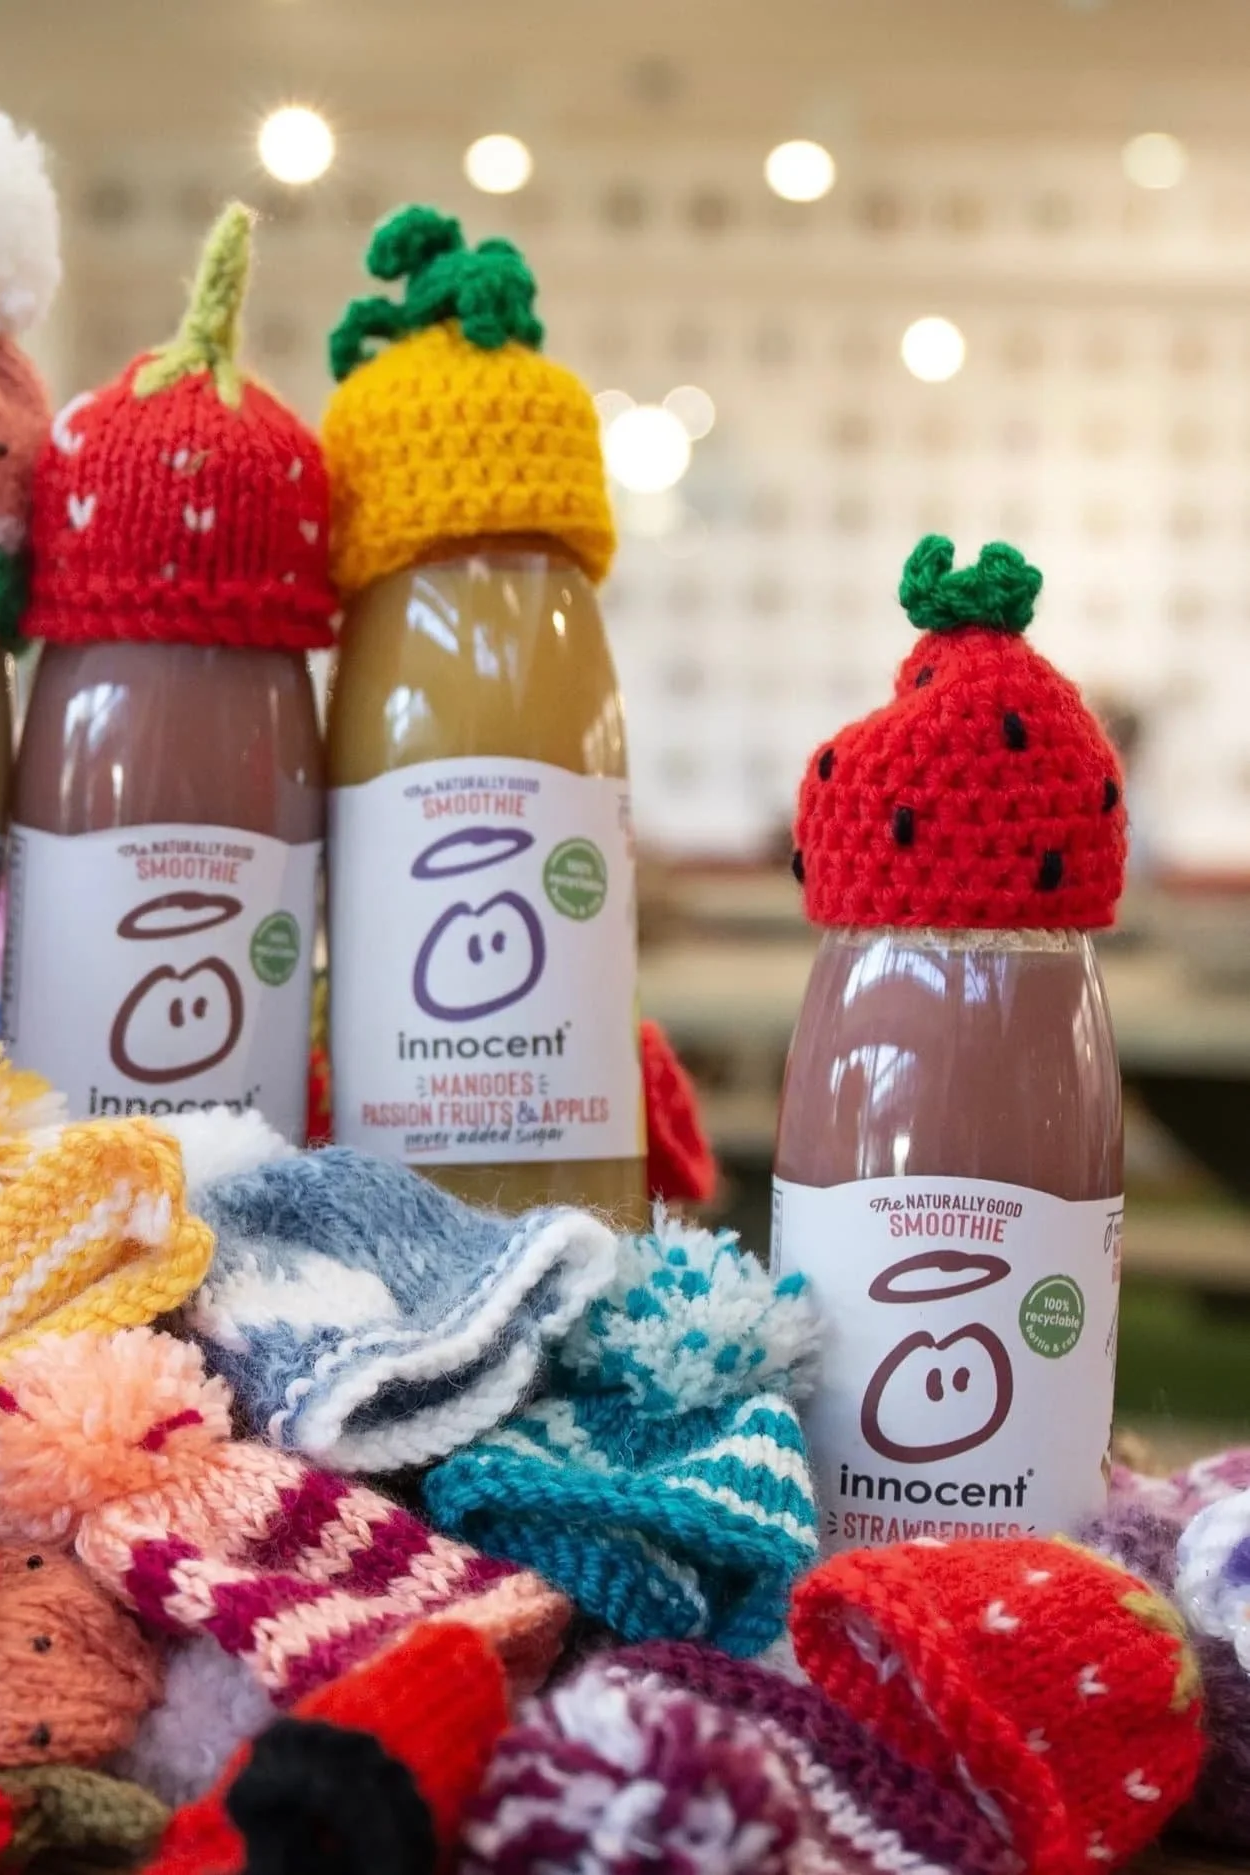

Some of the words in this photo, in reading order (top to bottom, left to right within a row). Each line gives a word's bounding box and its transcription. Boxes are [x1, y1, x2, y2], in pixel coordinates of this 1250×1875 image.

[422, 793, 527, 820] SMOOTHIE
[136, 857, 241, 884] SMOOTHIE
[430, 1071, 534, 1097] MANGOES
[361, 1101, 433, 1127] PASSION
[439, 1099, 513, 1127] FRUITS
[541, 1096, 610, 1124] APPLES
[870, 1197, 904, 1213] The
[906, 1194, 985, 1212] NATURALLY
[987, 1199, 1022, 1218] GOOD
[890, 1212, 1007, 1243] SMOOTHIE
[1044, 1297, 1069, 1312] 100%
[1025, 1311, 1079, 1328] recyclable
